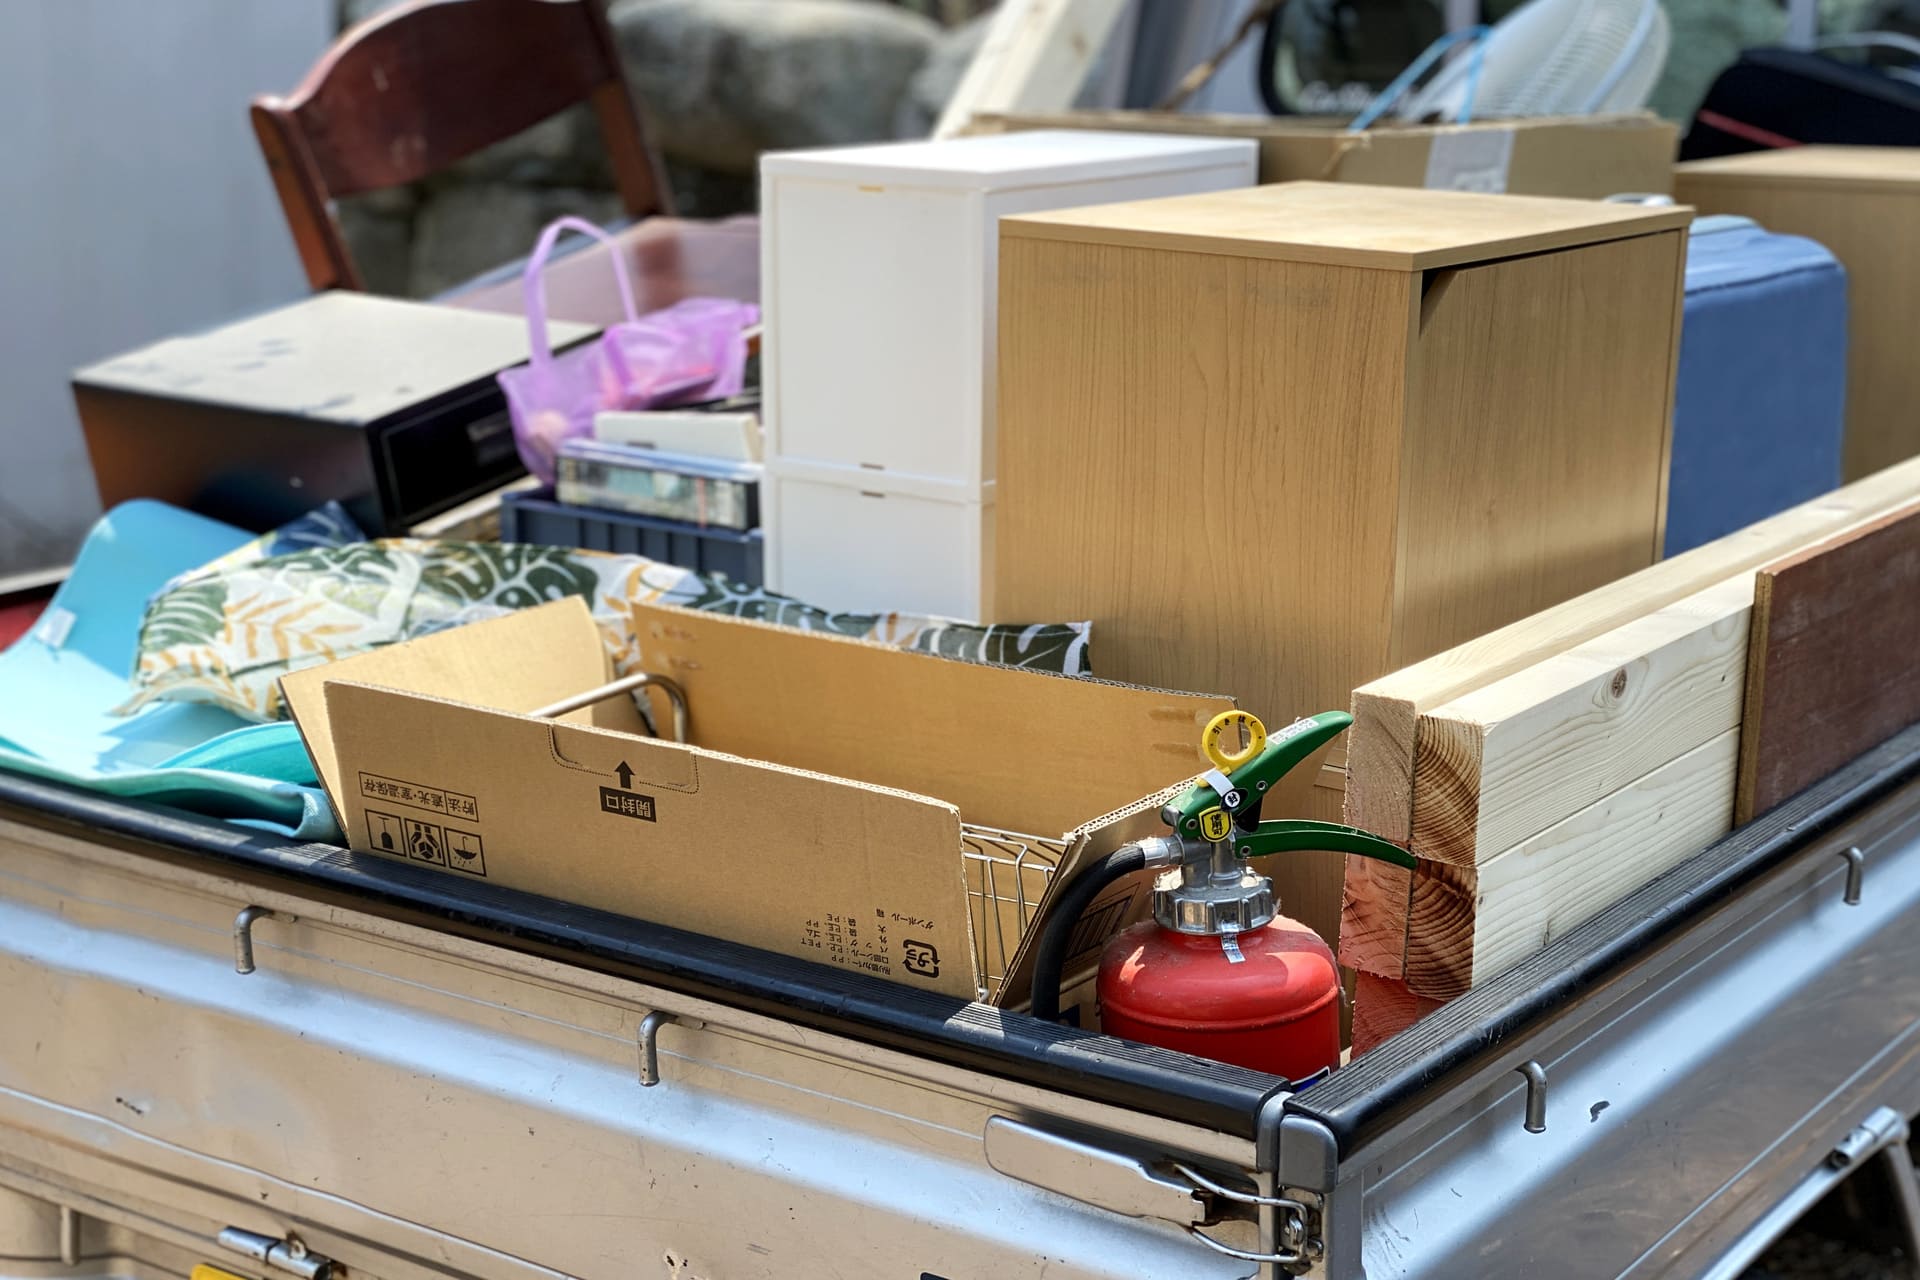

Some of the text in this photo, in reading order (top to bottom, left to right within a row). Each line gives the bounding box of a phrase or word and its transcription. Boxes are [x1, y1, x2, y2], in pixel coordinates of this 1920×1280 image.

[447, 797, 475, 815] 貯法
[606, 794, 650, 817] 開封口
[891, 912, 934, 930] ダンボール
[905, 949, 930, 968] プラ
